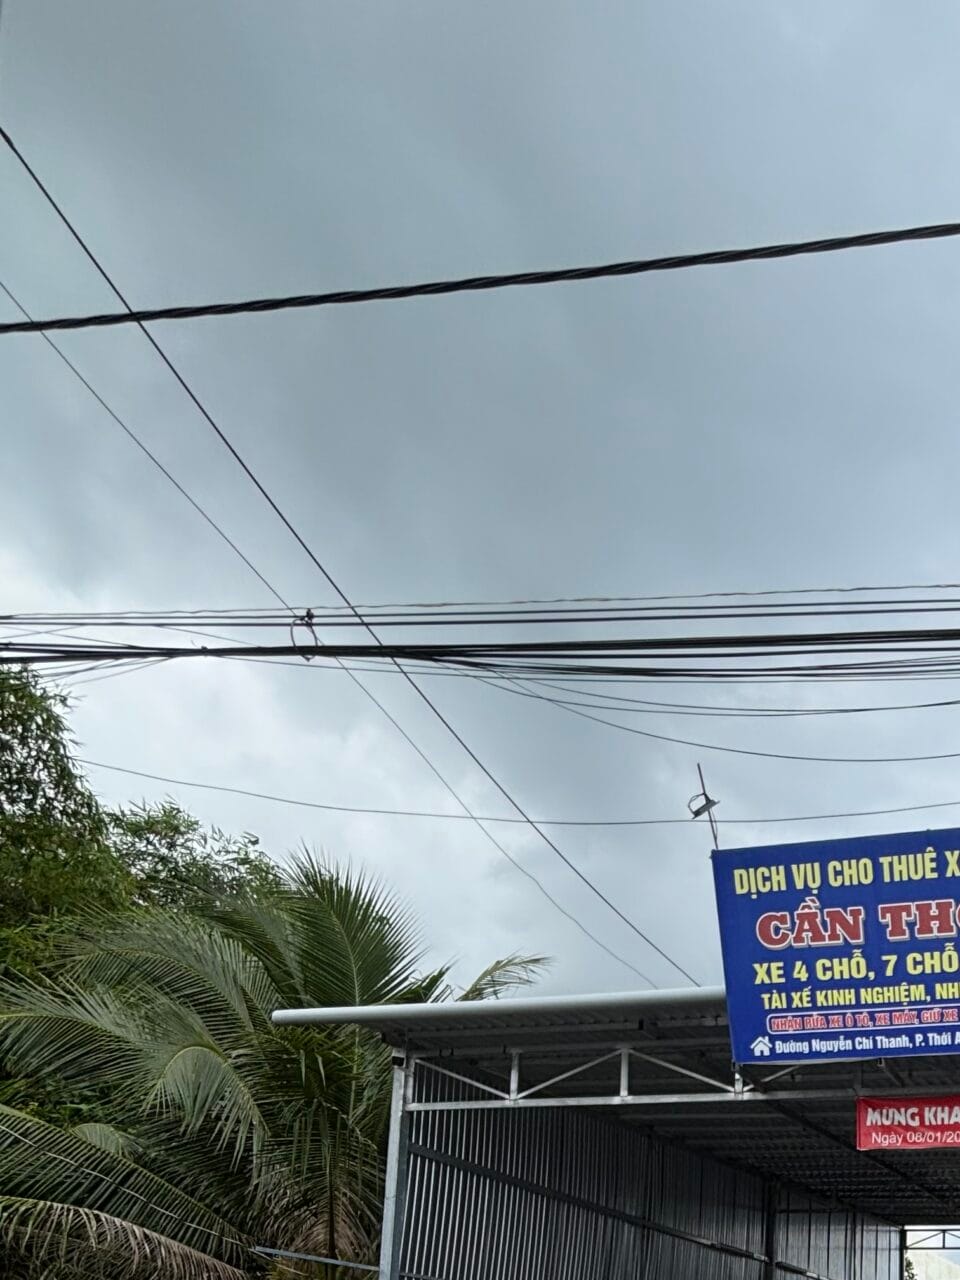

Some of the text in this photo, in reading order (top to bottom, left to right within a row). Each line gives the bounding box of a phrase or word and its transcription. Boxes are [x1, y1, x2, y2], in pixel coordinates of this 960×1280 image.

[733, 866, 786, 899] DỊCH
[791, 861, 821, 894] VỤ
[828, 858, 873, 887] CHO
[879, 847, 938, 882] THUÊ
[756, 897, 865, 950] CẦN
[752, 962, 785, 984] XE
[792, 961, 808, 981] 4
[815, 949, 875, 981] CHỖ,
[881, 955, 898, 976] 7
[761, 990, 787, 1009] TÀI
[791, 986, 812, 1008] XẾ
[816, 988, 855, 1006] KINH
[860, 981, 931, 1006] NGHIỆM,
[829, 1014, 843, 1028] XE
[875, 1012, 890, 1025] XE
[943, 1009, 959, 1022] XE
[775, 1039, 809, 1054] Đường
[855, 1036, 873, 1050] Chí
[875, 1035, 913, 1049] Thanh,
[915, 1034, 925, 1046] P.
[871, 1131, 903, 1146] Ngày
